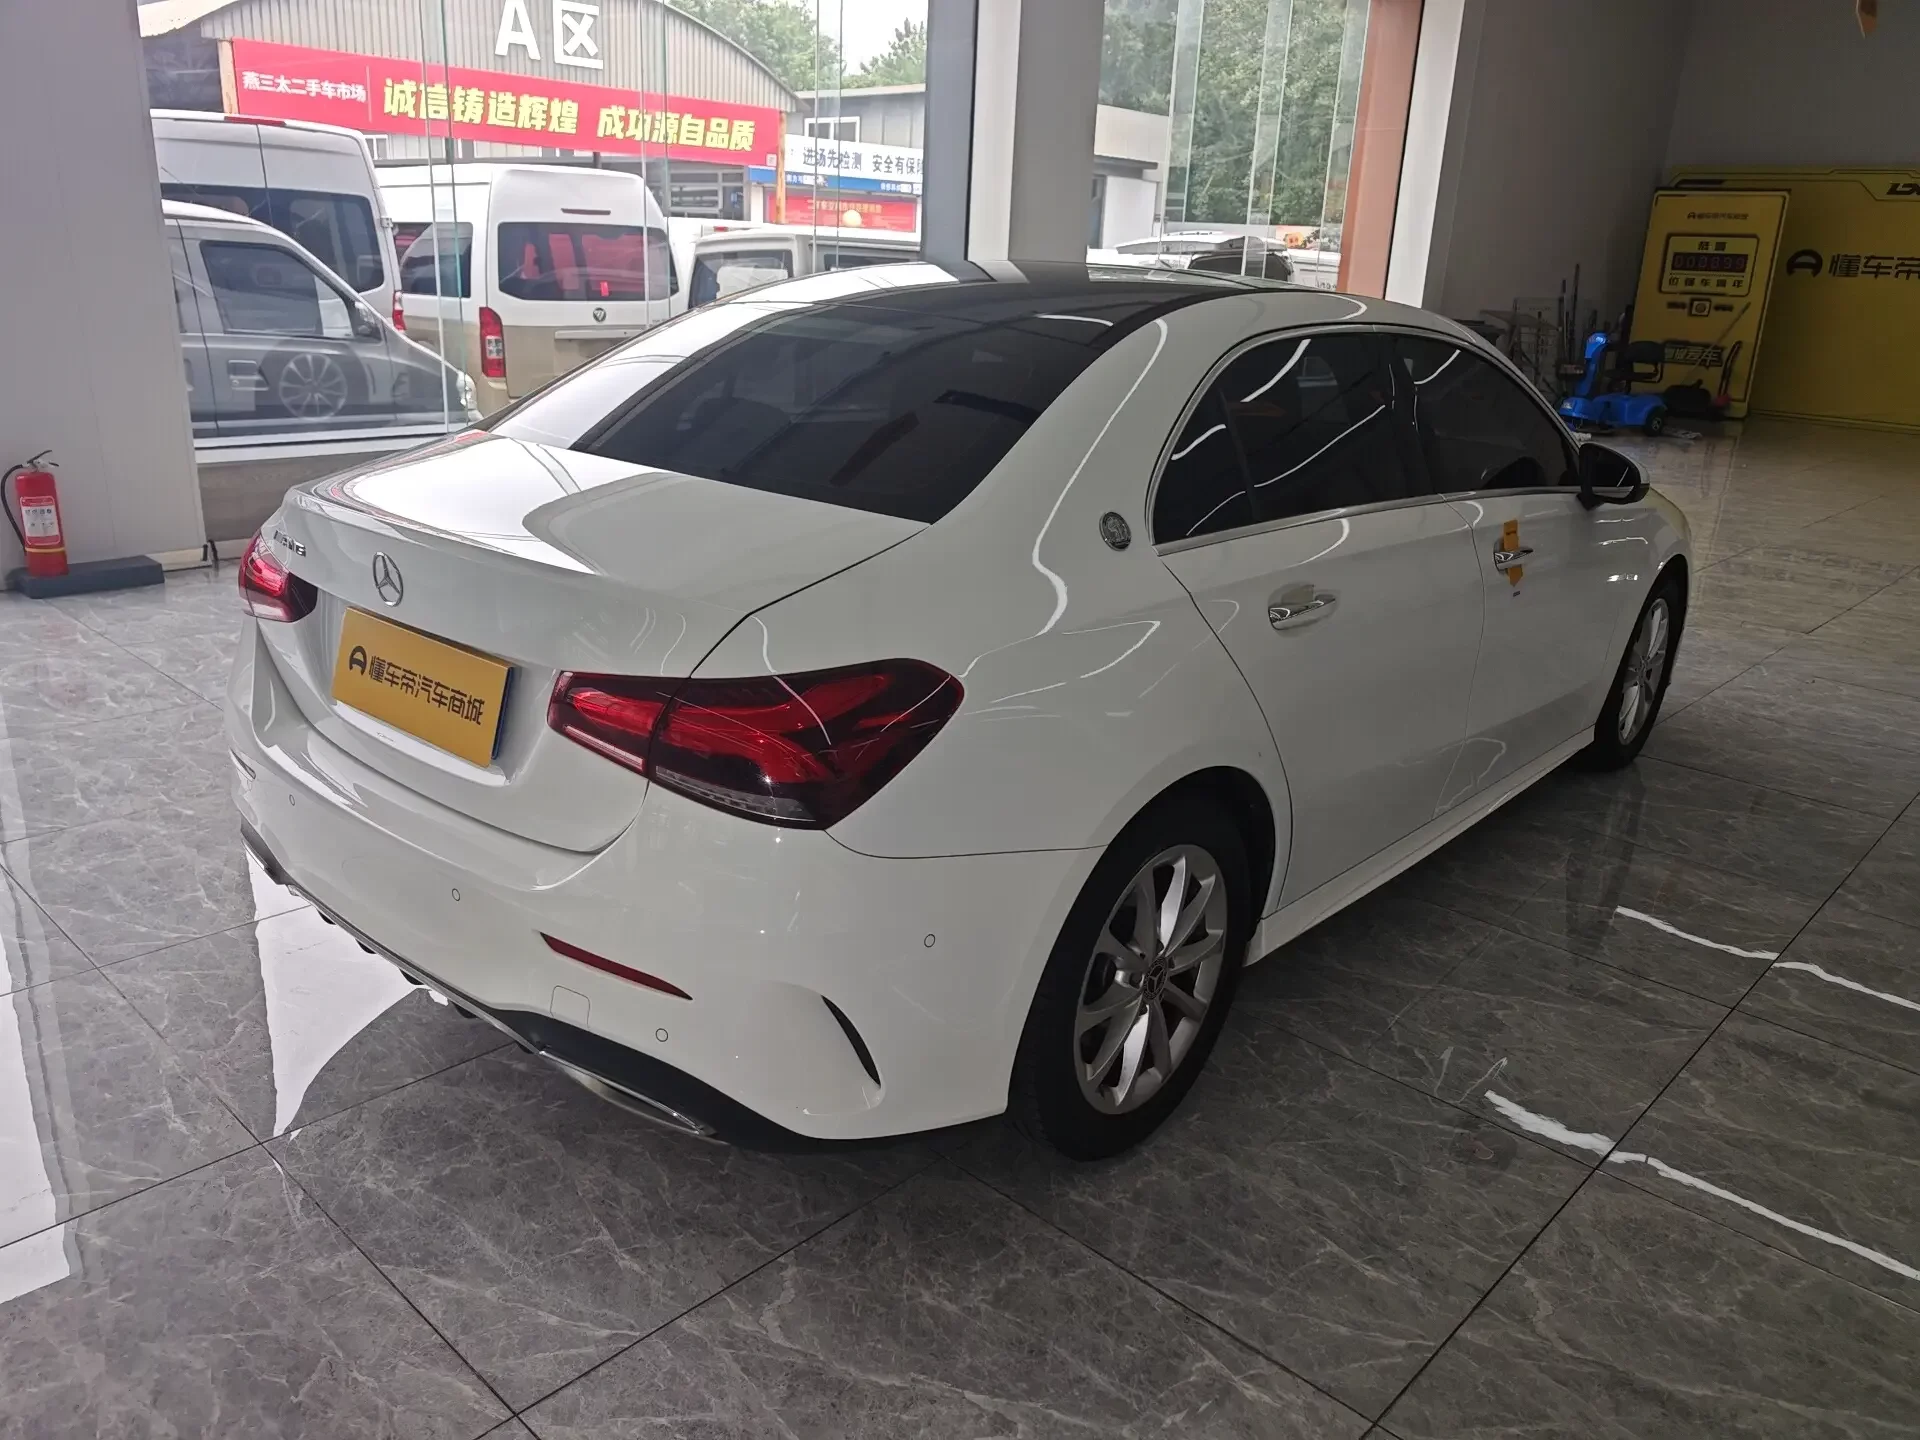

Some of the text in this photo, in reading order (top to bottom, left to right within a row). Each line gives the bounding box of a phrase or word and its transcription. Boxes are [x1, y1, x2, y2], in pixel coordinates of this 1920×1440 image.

[494, 0, 604, 69] A区
[242, 70, 367, 104] 燕三太二手车市场
[384, 78, 756, 152] 诚信铸造辉煌 成功源自品质
[369, 654, 485, 725] 懂车帝汽车商城
